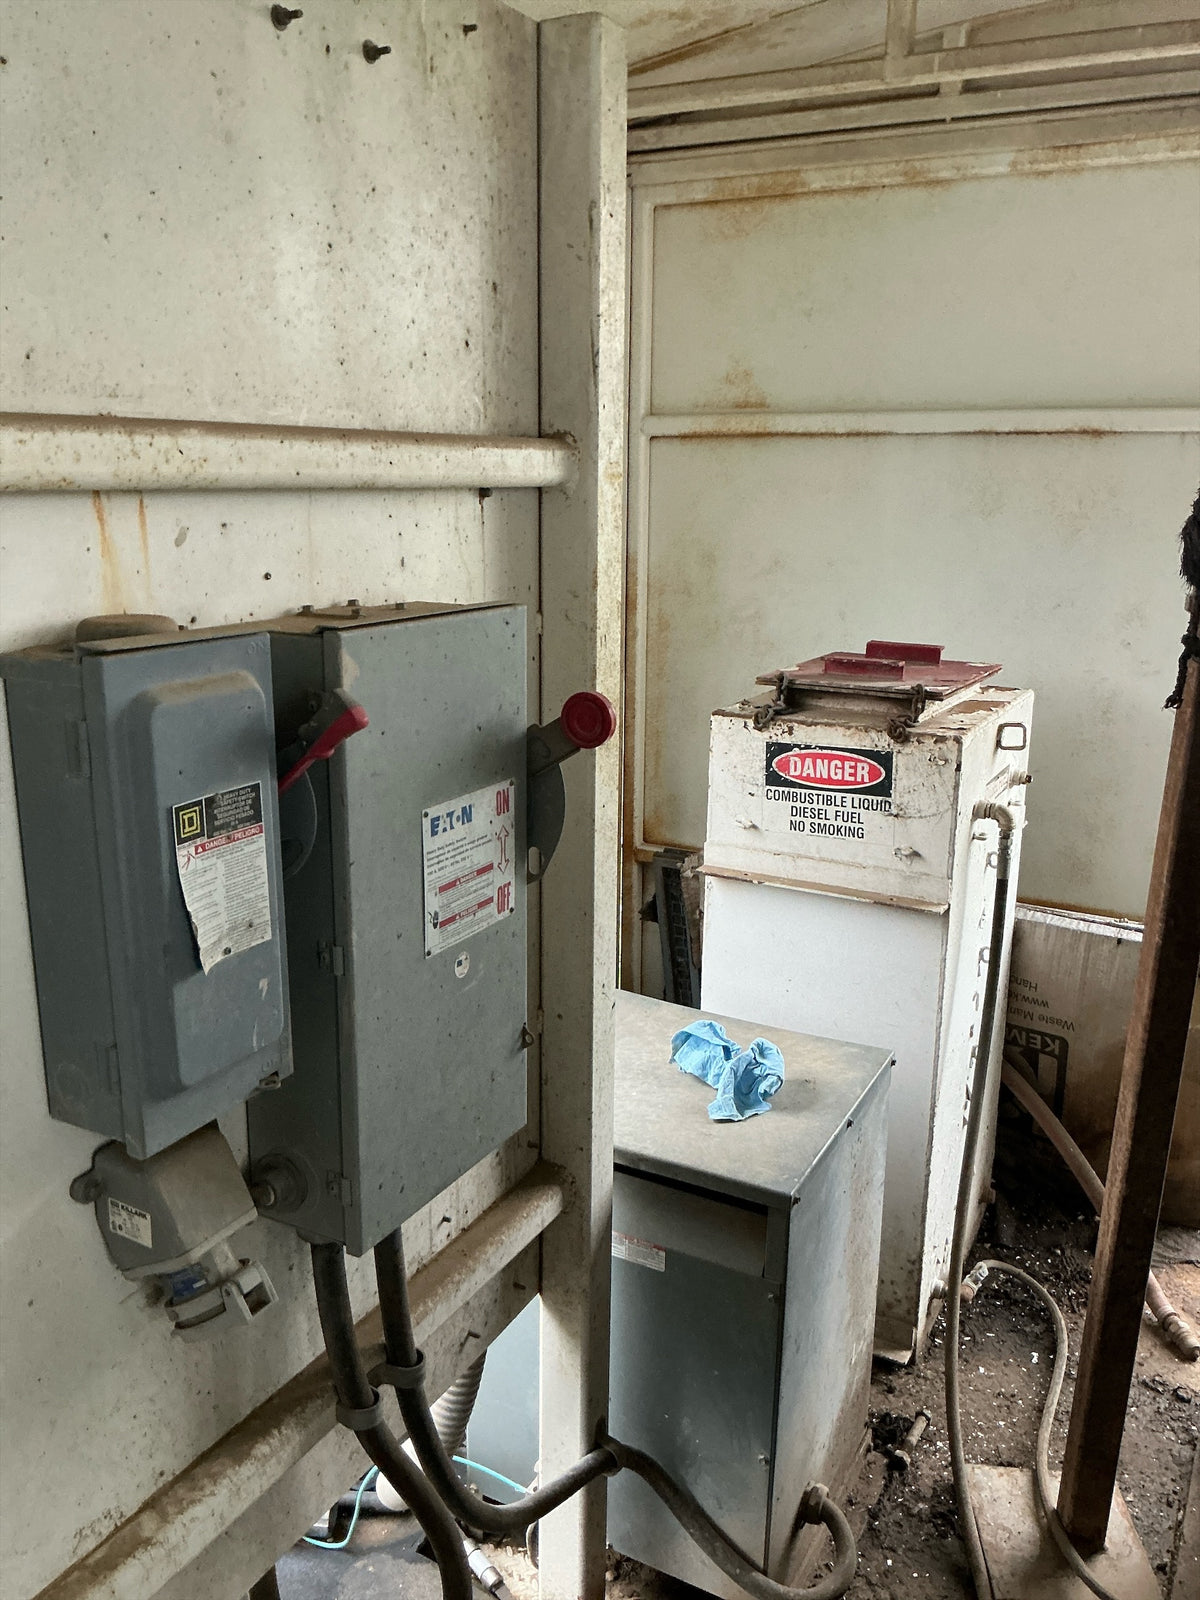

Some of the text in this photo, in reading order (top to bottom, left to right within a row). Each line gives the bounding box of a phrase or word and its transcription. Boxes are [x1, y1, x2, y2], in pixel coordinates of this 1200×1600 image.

[788, 756, 870, 783] DANGER
[495, 787, 511, 817] ON
[766, 788, 892, 813] COMBUSTIBLE LIQUID
[430, 803, 473, 838] EATON
[790, 805, 864, 825] DIESEL FUEL
[234, 826, 261, 840] PELIGRO
[789, 819, 806, 833] NO
[809, 821, 865, 839] SMOKING
[496, 880, 512, 915] OFF
[1038, 1014, 1075, 1032] Waste
